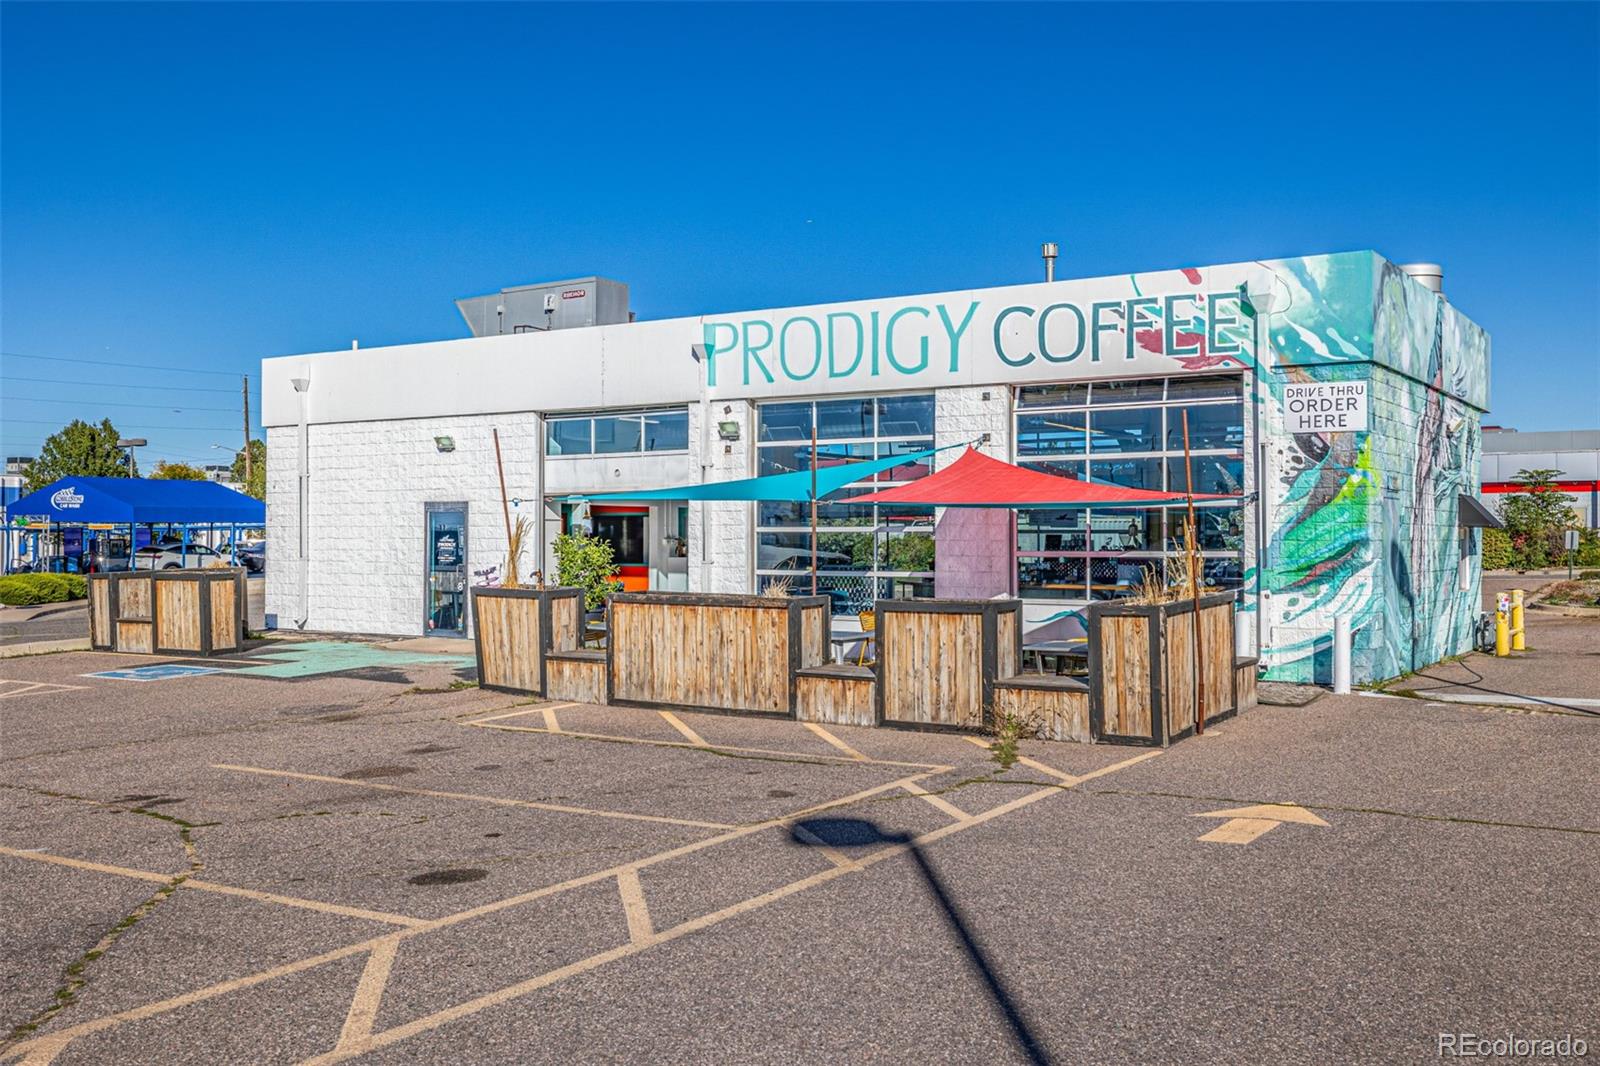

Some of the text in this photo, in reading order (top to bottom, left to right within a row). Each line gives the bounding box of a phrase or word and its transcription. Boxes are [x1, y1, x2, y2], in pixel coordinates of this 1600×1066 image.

[704, 291, 1242, 387] PRODIGY COFFEE
[1286, 385, 1364, 398] DRIVE THRU
[1289, 397, 1358, 413] ORDER
[1299, 414, 1347, 429] HERE
